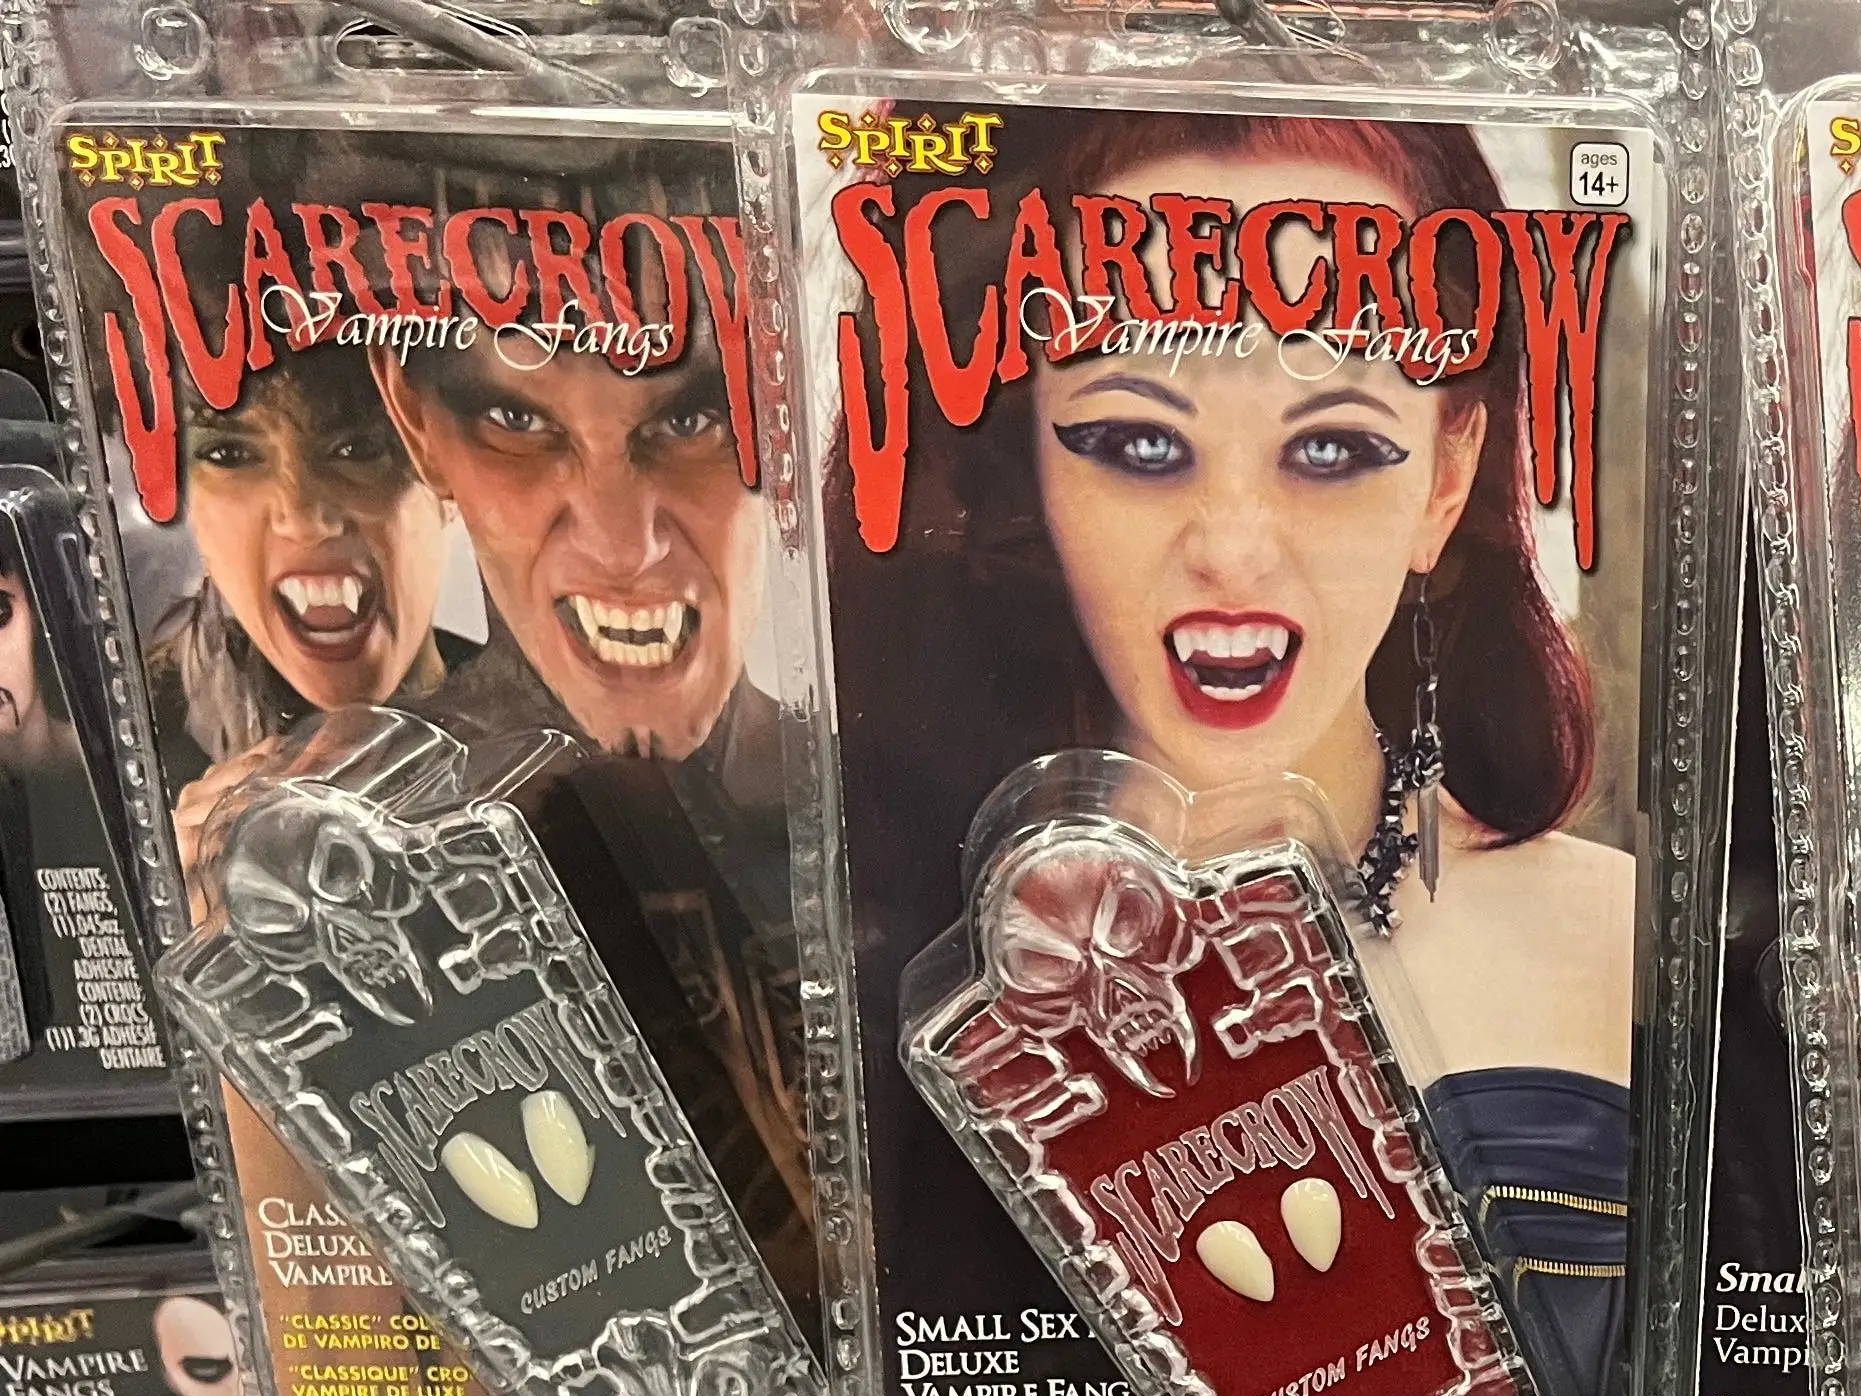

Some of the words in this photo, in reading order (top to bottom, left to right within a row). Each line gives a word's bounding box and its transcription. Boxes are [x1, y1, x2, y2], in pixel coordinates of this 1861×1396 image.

[68, 132, 225, 190] SPIRIT
[816, 109, 1004, 176] SPIRIT
[1580, 151, 1619, 168] ages
[1578, 172, 1619, 197] 14+
[260, 283, 478, 366] Vampire
[494, 299, 674, 376] Fangs
[1019, 287, 1262, 379] Vampire
[1277, 306, 1480, 387] Fangs
[830, 181, 1631, 574] SCARECROW
[350, 1000, 627, 1228] SCARECROW
[259, 1198, 347, 1229] CLAS
[1092, 1066, 1396, 1327] SCARECROW
[520, 1264, 599, 1316] CUSTOM
[605, 1225, 672, 1275] FANGS
[896, 1311, 1011, 1346] SMALL
[1020, 1308, 1094, 1343] SEX
[1715, 1304, 1807, 1333] Delux
[284, 1334, 307, 1349] DE
[314, 1334, 410, 1350] VAMPIRO
[1355, 1314, 1432, 1375] FANGS
[1713, 1337, 1810, 1373] Vampi
[0, 1348, 148, 1382] VAMPIRE
[426, 1366, 472, 1382] CRO
[899, 1348, 1020, 1381] DELUXE
